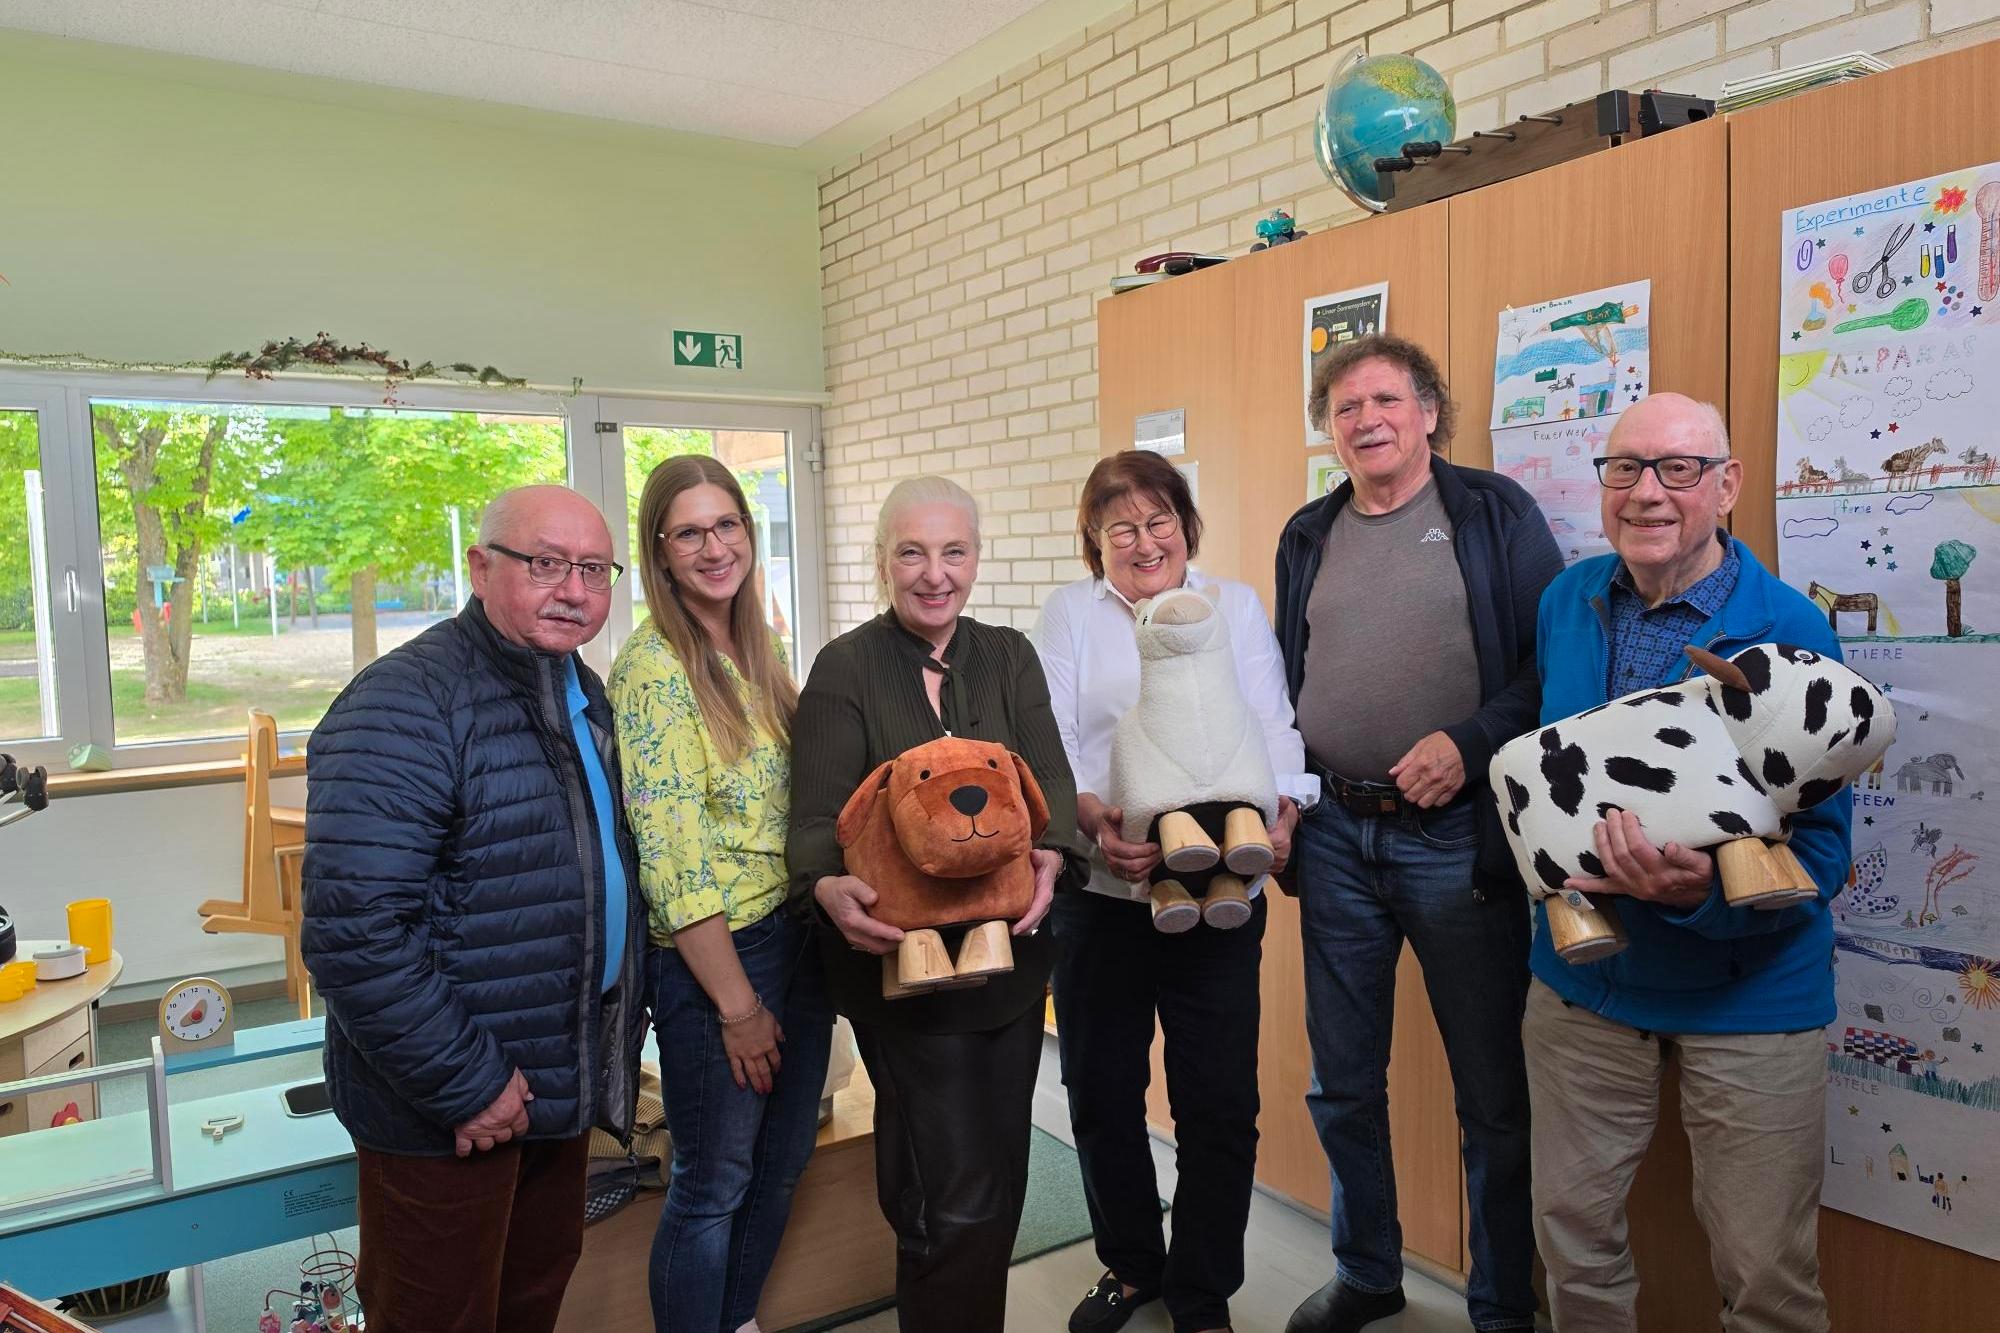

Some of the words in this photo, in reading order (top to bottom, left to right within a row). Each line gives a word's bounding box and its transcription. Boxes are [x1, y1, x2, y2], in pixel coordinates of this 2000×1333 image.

[1795, 185, 1926, 230] Experimente
[1848, 647, 1904, 660] TIERE
[1853, 793, 1896, 807] FEEN
